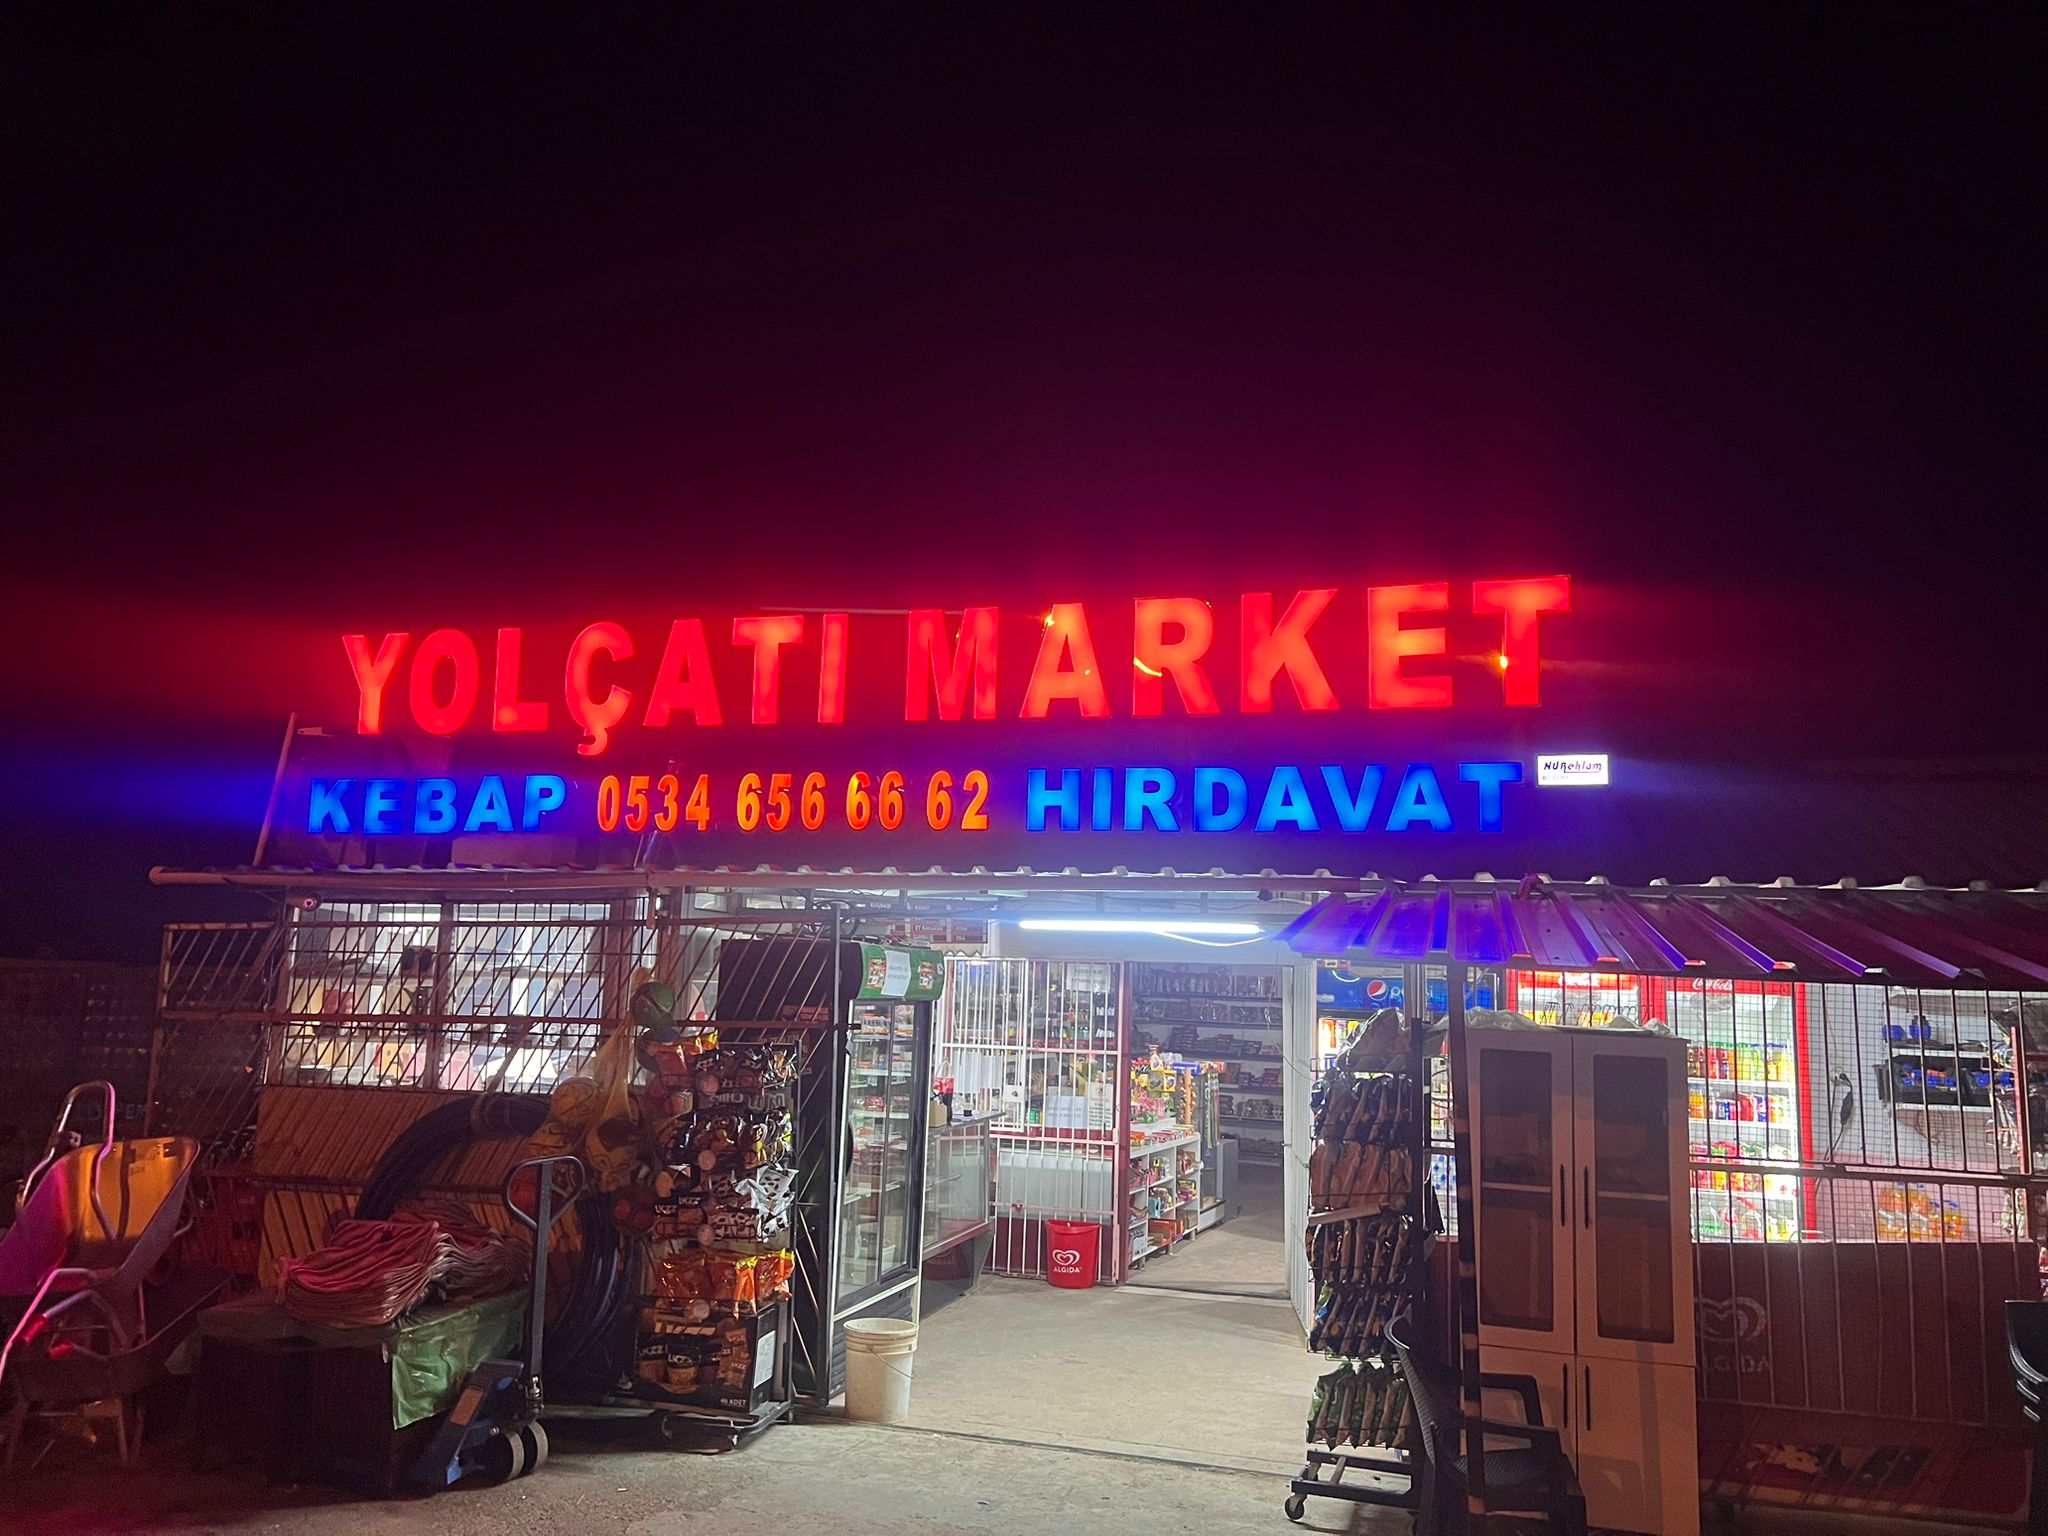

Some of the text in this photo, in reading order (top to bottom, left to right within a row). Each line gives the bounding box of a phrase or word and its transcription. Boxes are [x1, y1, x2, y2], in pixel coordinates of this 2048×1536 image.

[341, 574, 1572, 757] YOLÇATI MARKET
[306, 761, 1523, 834] KEBAP 0534 656 66 62 HIRDAVAT
[1053, 1266, 1081, 1274] ALGIDA
